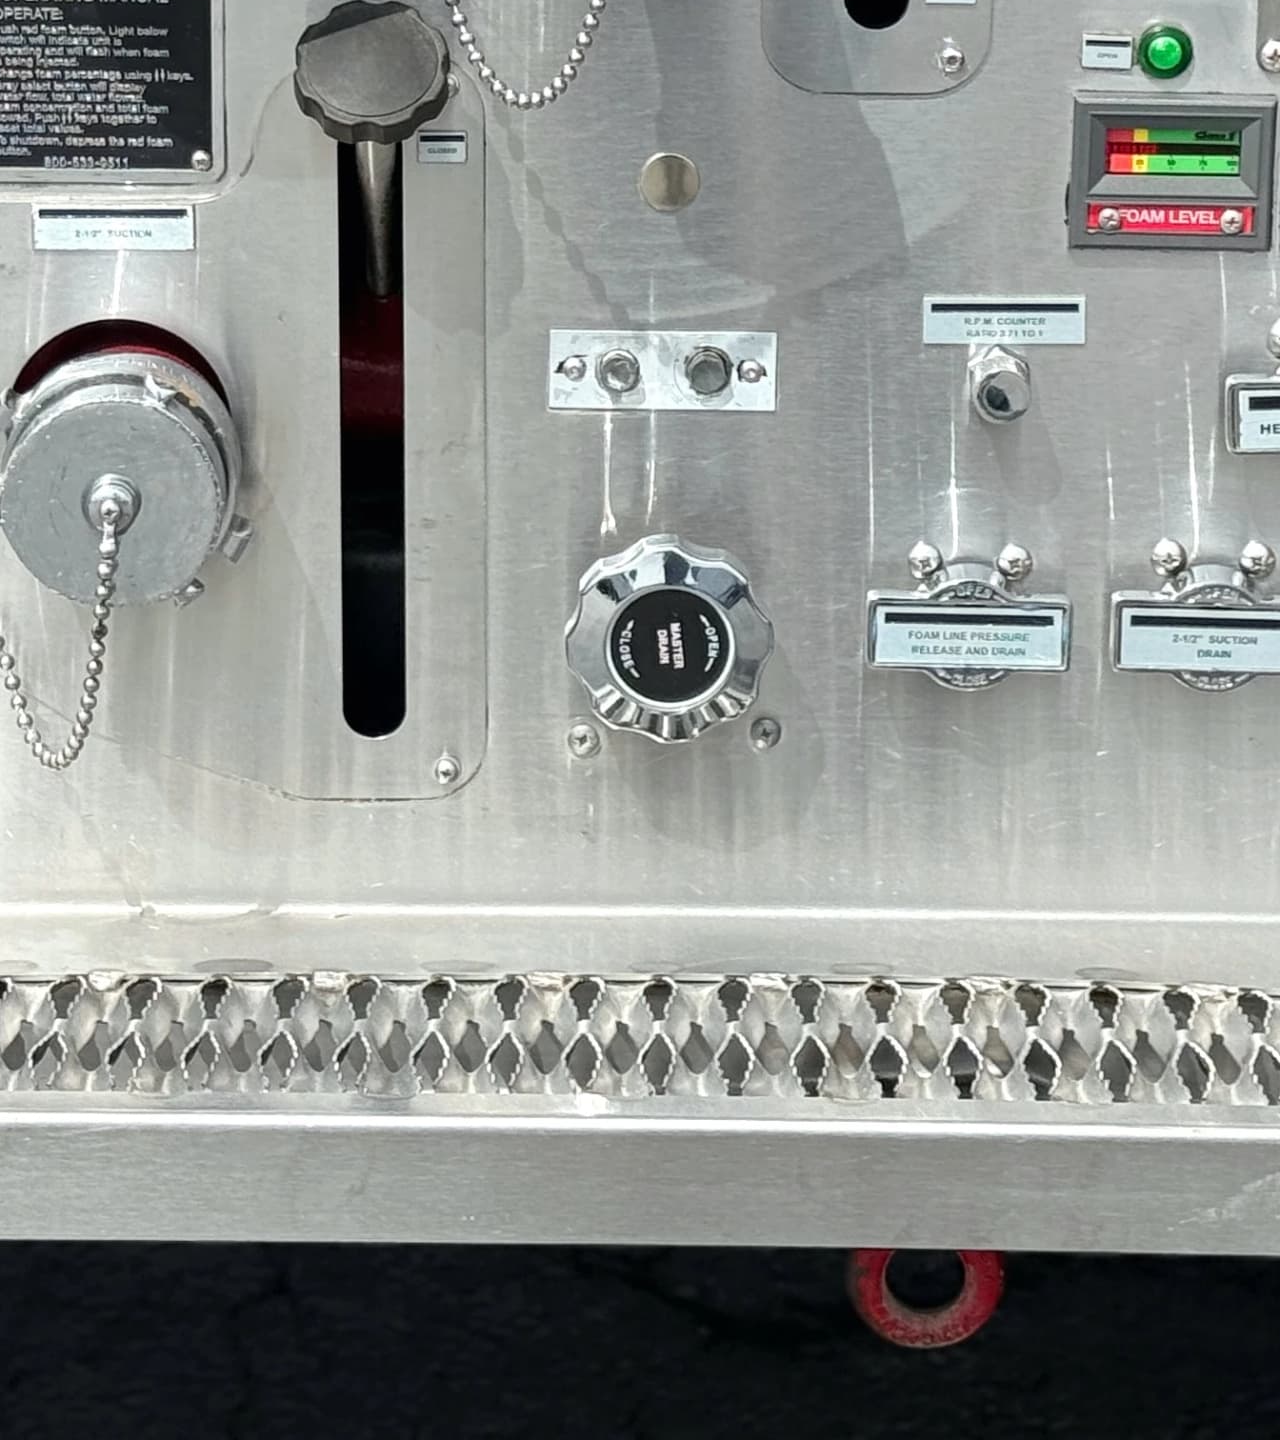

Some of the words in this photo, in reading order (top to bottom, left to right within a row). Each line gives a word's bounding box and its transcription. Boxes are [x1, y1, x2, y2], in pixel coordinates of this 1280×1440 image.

[40, 24, 68, 35] foam
[109, 25, 134, 38] Light
[137, 26, 168, 37] below
[1121, 209, 1165, 223] FOAM
[1169, 211, 1219, 225] LEVEL
[997, 317, 1047, 326] COUNTER
[1022, 329, 1035, 337] TO
[704, 626, 720, 658] OPEN
[908, 630, 941, 640] FOAM
[943, 631, 968, 641] LINE
[970, 632, 1031, 642] PRESSURE
[1172, 633, 1204, 644] 2-1/2"
[1208, 634, 1258, 645] SUCTION
[619, 630, 635, 669] CLOSE
[656, 628, 670, 665] DRAIN
[669, 622, 685, 670] MASTER
[911, 645, 962, 655] RELEASE
[965, 646, 989, 656] AND
[991, 646, 1026, 657] DRAIN
[1196, 649, 1233, 659] DRAIN
